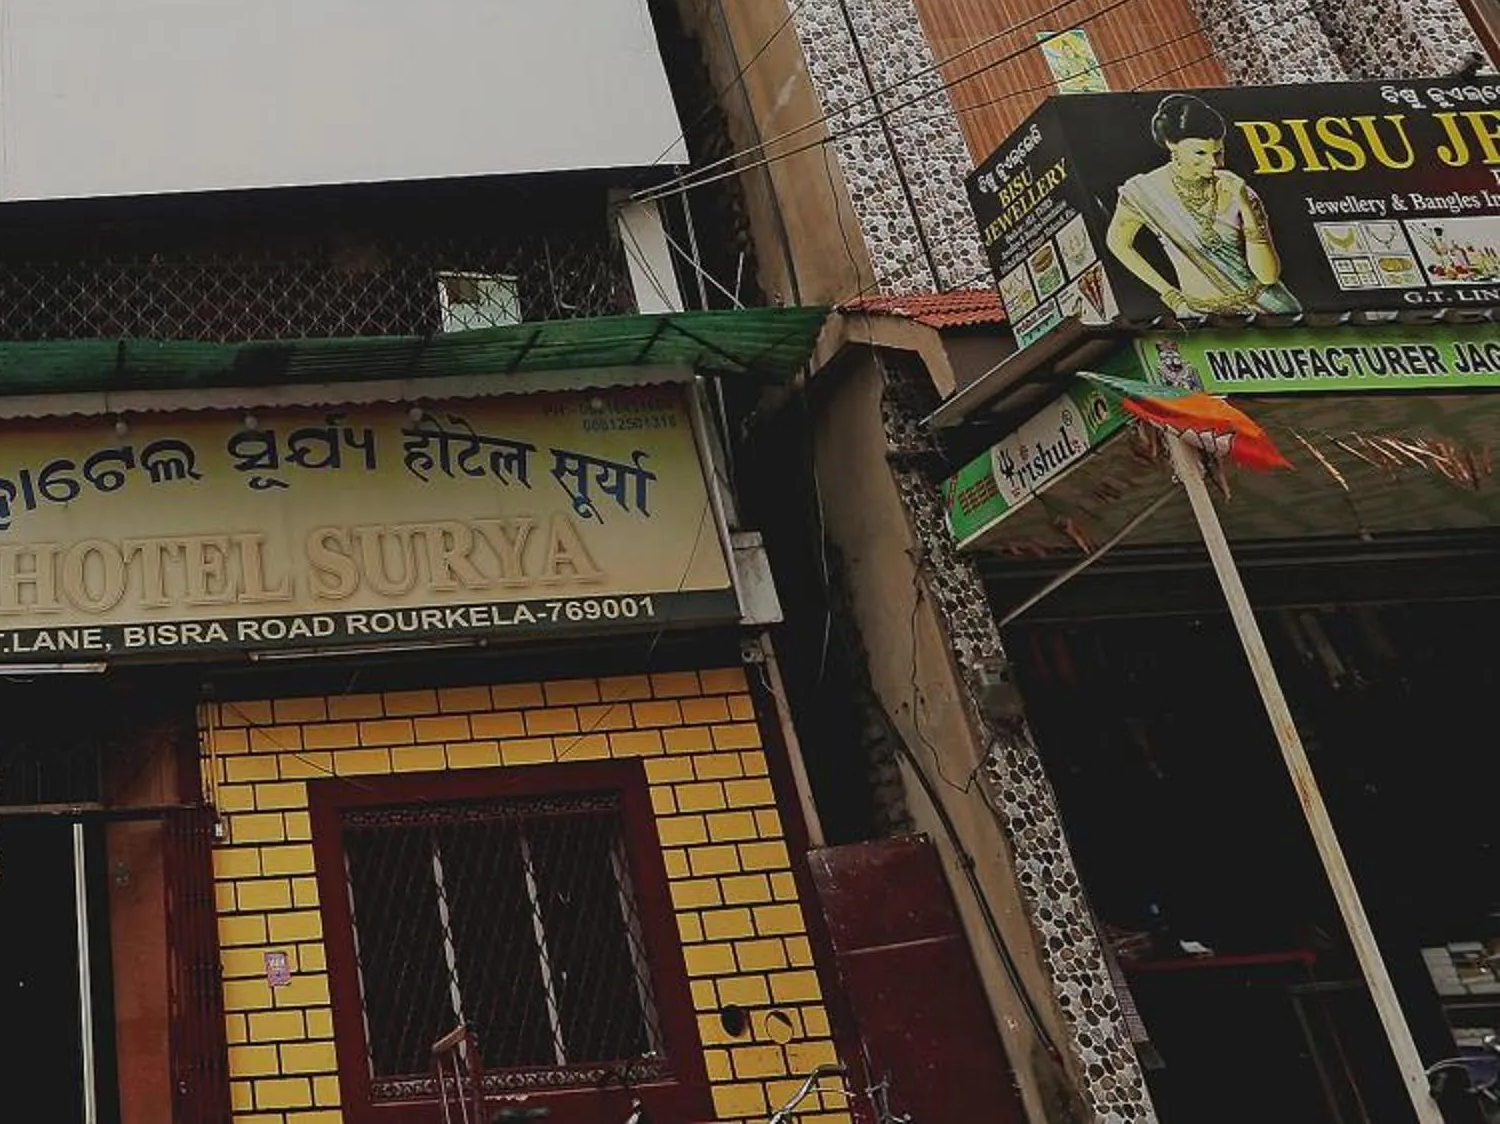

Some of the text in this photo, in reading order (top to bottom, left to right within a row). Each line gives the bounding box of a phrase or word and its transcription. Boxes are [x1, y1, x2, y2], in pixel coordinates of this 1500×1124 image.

[1234, 114, 1415, 174] BISU
[984, 157, 1069, 247] JEWELLERY
[999, 165, 1034, 208] BISU
[1305, 194, 1387, 216] Jewellery
[1391, 194, 1405, 212] &
[1407, 191, 1481, 214] Bangles
[1403, 289, 1452, 304] G.T.
[1205, 344, 1448, 381] MANUFACTURER
[401, 413, 537, 489] होटेल
[304, 513, 605, 605] SURYA
[123, 622, 228, 648] BISRA
[237, 614, 335, 641] ROAD
[346, 595, 656, 634] ROURKELA-769001
